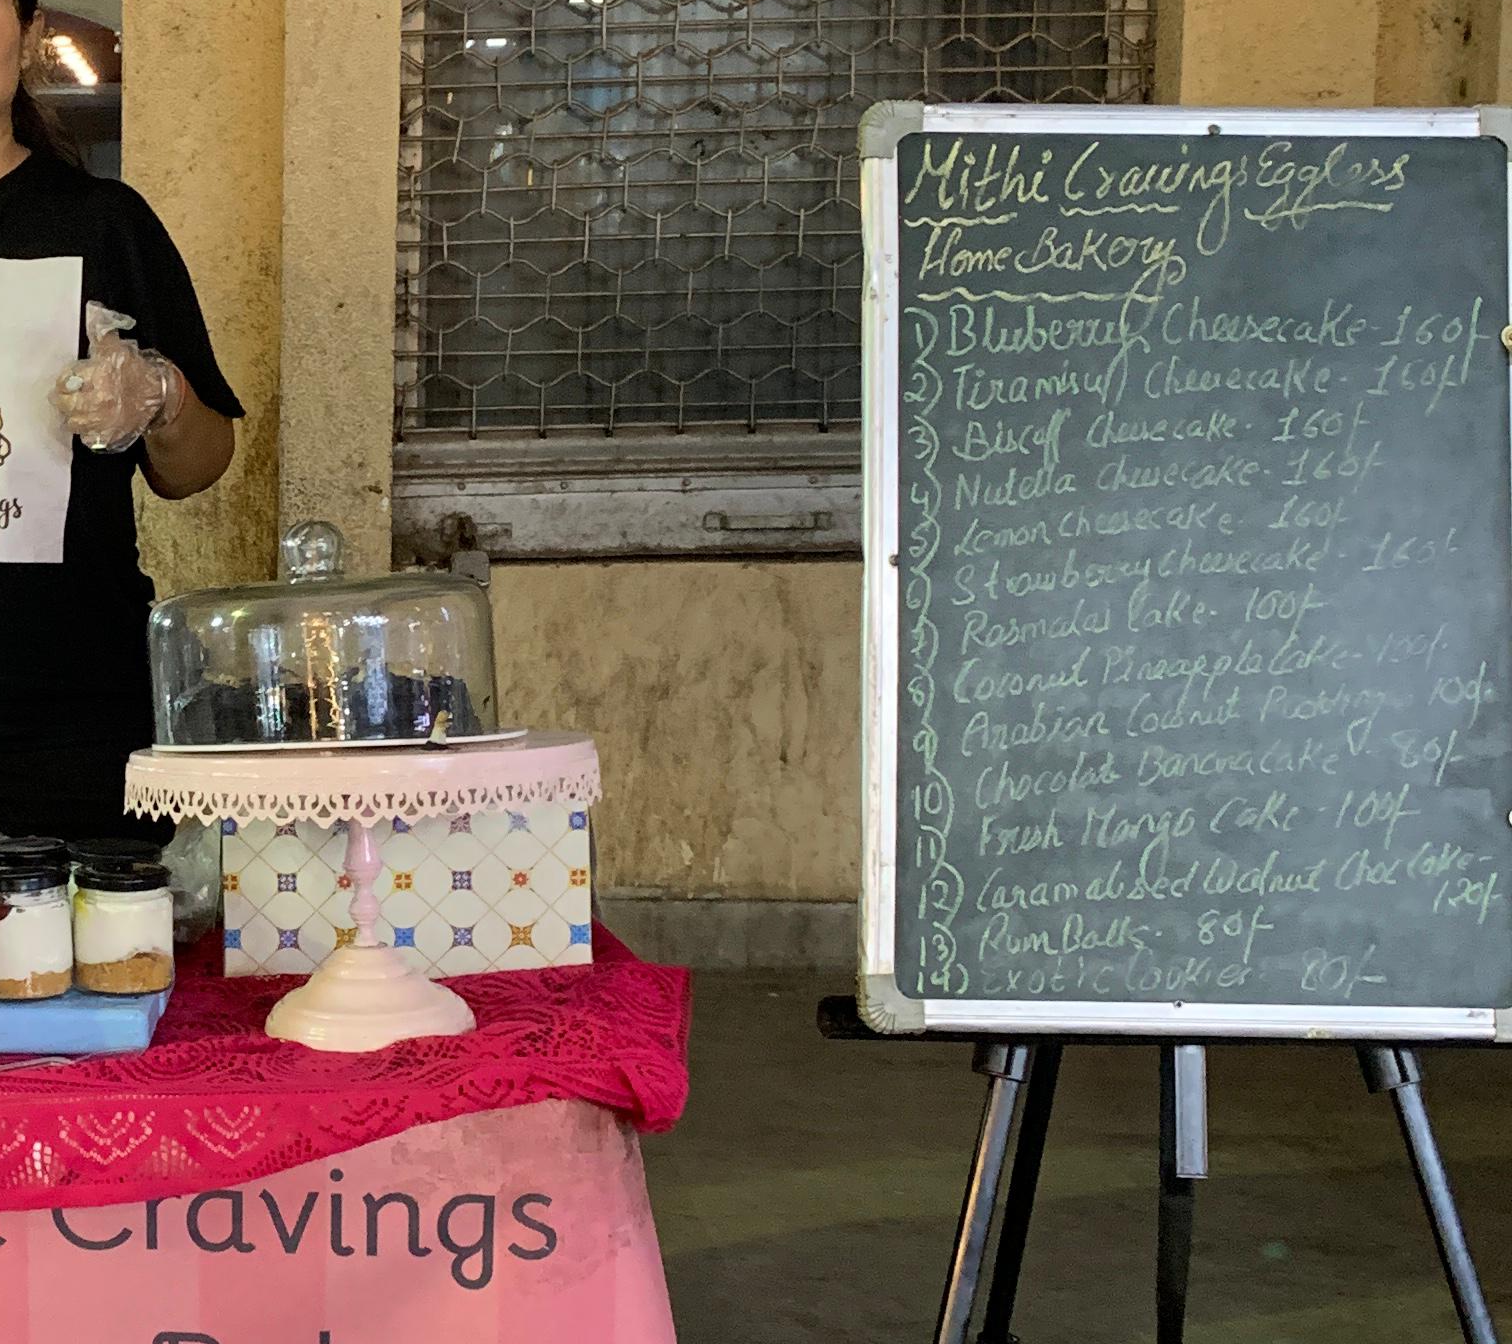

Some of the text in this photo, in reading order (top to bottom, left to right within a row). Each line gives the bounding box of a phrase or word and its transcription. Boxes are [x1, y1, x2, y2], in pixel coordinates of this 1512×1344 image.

[904, 137, 1050, 211] Mithi
[918, 226, 1013, 280] Home
[979, 912, 1058, 961] Rum
